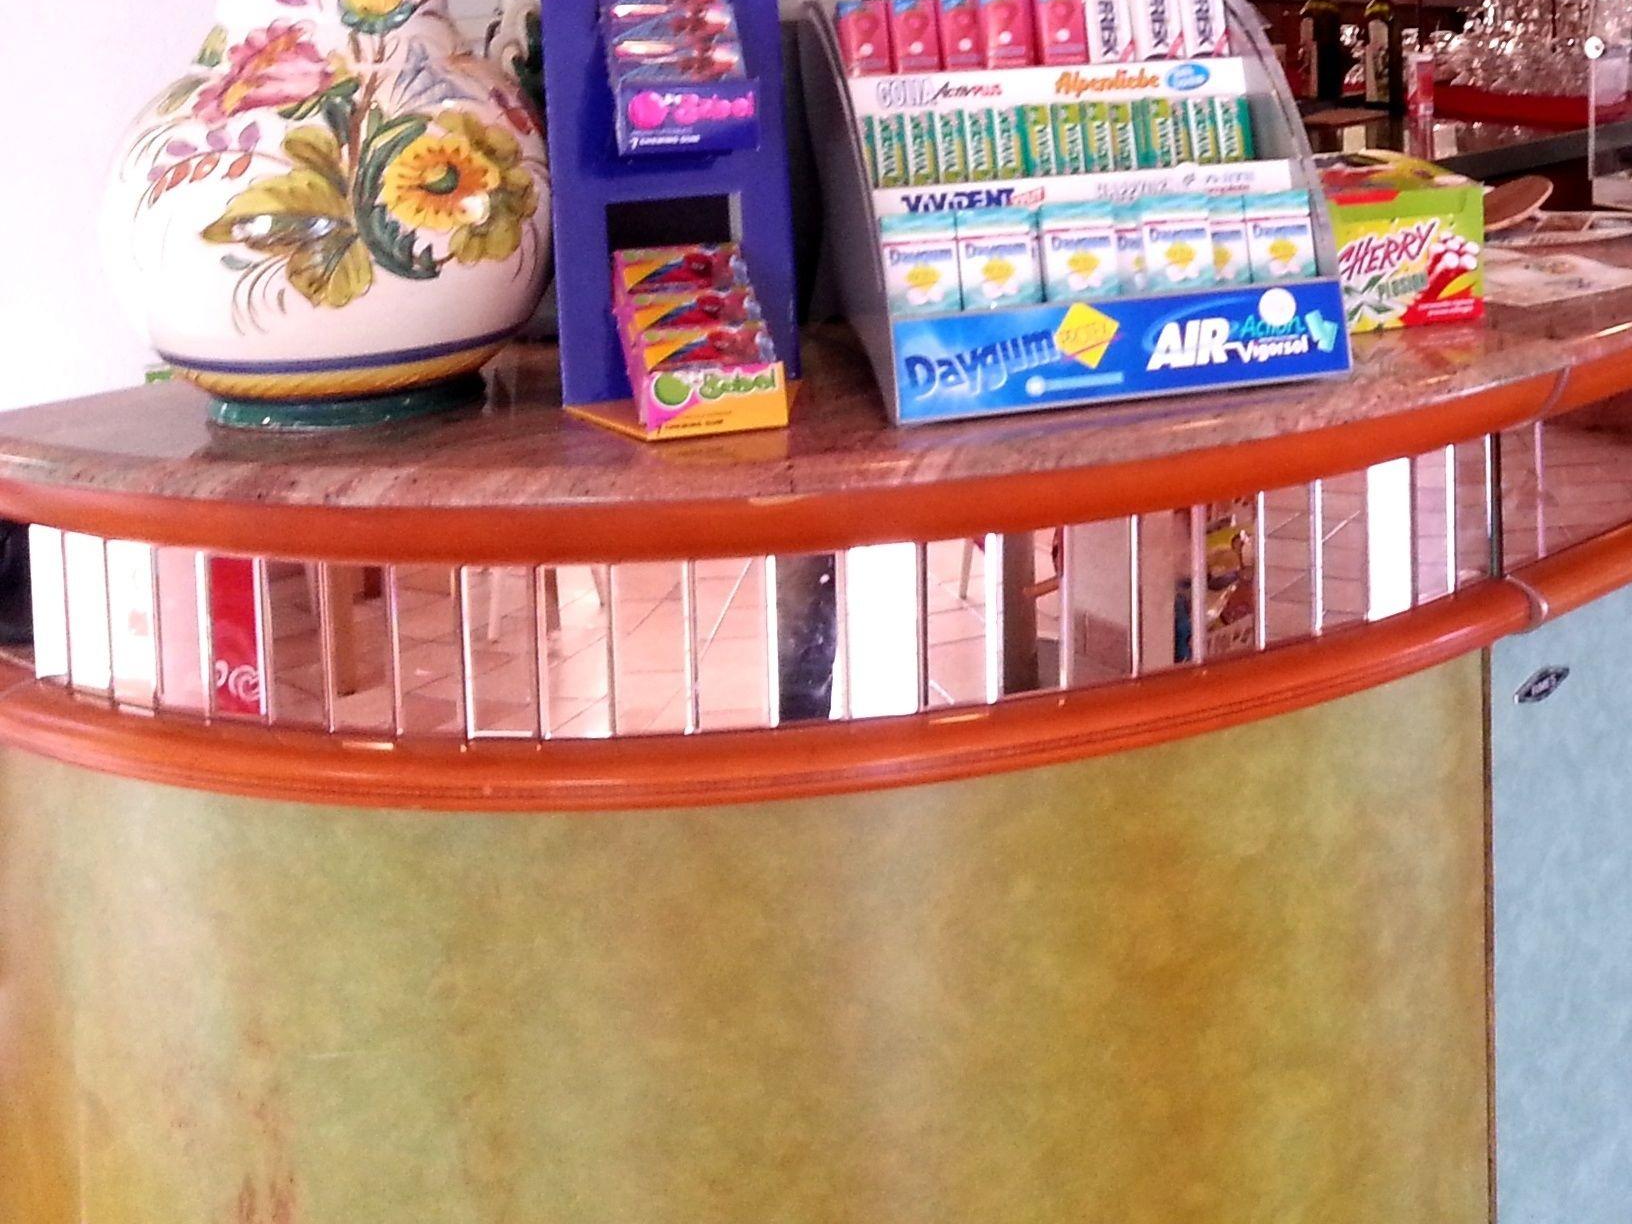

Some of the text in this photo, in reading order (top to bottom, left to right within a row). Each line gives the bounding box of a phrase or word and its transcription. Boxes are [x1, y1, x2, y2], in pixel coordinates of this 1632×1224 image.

[1338, 221, 1437, 281] CHERRY
[904, 329, 1062, 403] Daygum
[1146, 317, 1230, 372] AIR
